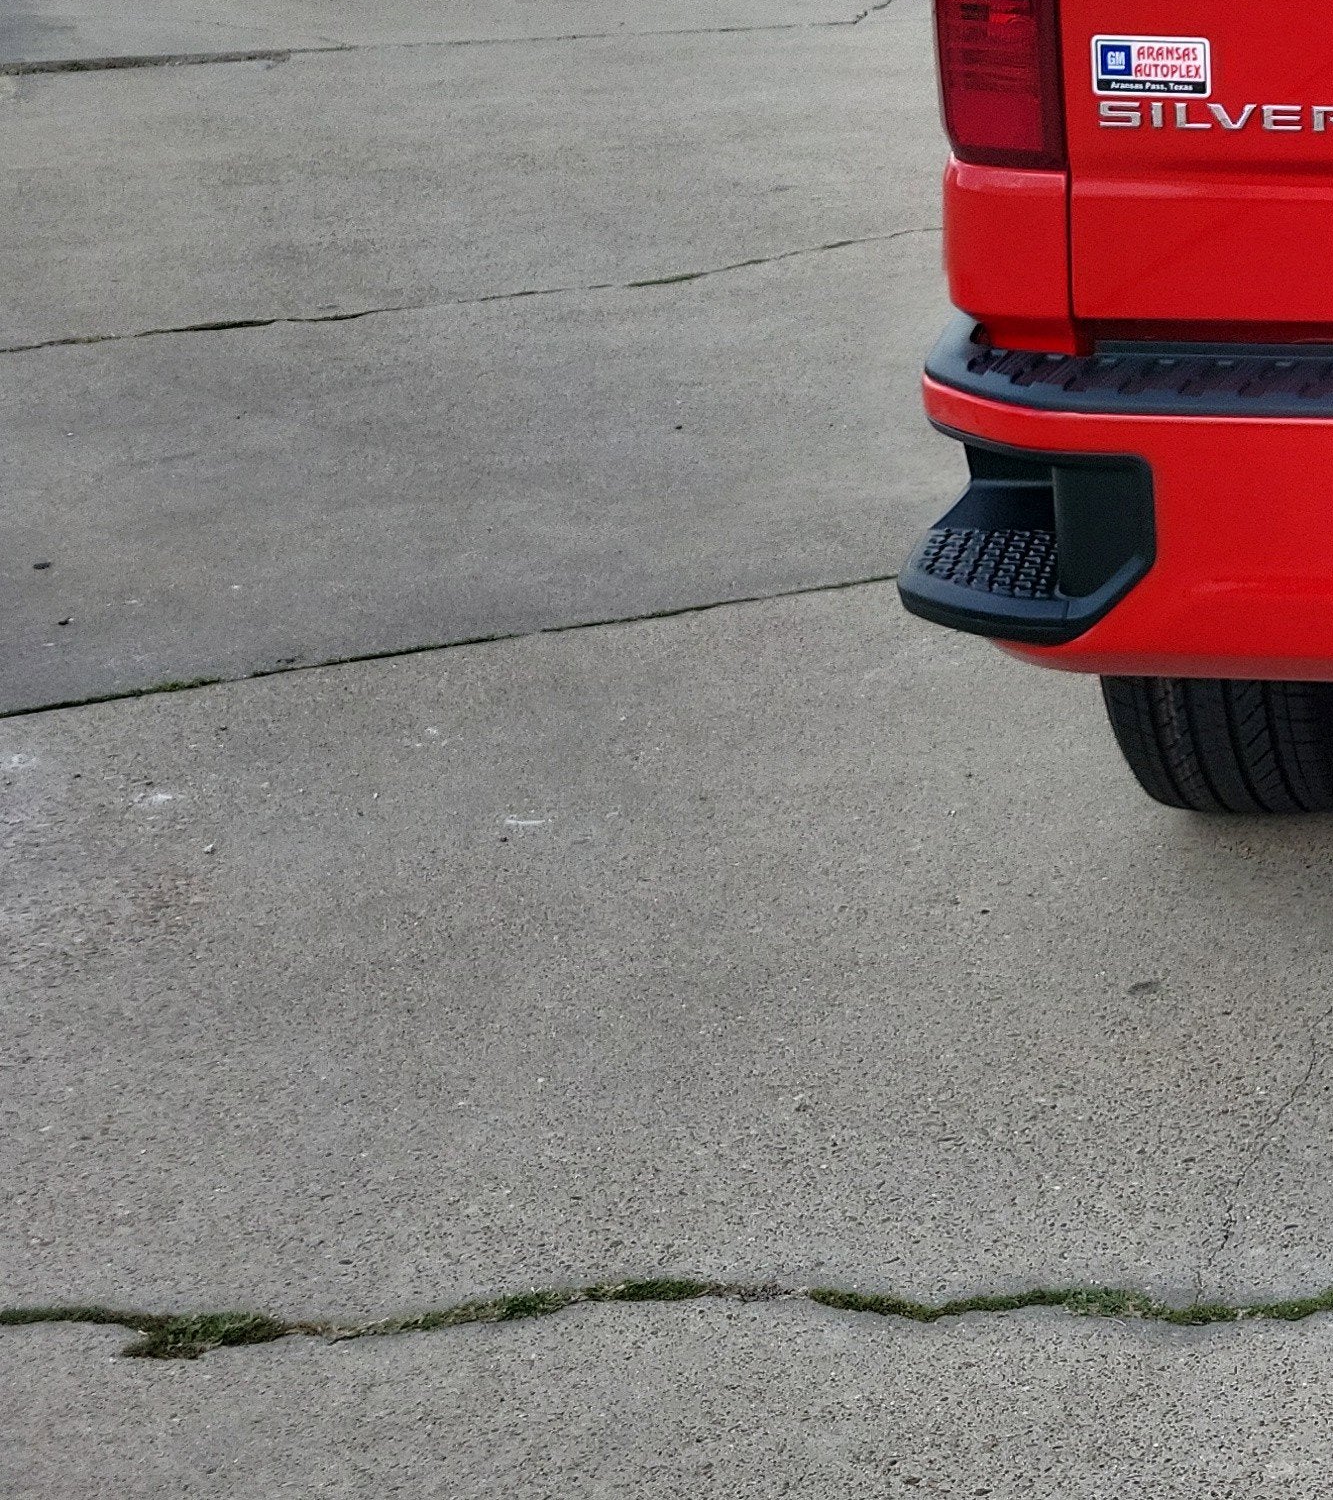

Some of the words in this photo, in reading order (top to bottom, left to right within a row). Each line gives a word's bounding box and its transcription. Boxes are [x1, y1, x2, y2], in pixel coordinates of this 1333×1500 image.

[1107, 51, 1126, 66] GM
[1137, 46, 1198, 61] ARANSAS
[1134, 63, 1202, 79] AUTOPLEX
[1110, 81, 1143, 90] Aransas
[1145, 82, 1168, 92] Pass,
[1169, 83, 1193, 92] Texas
